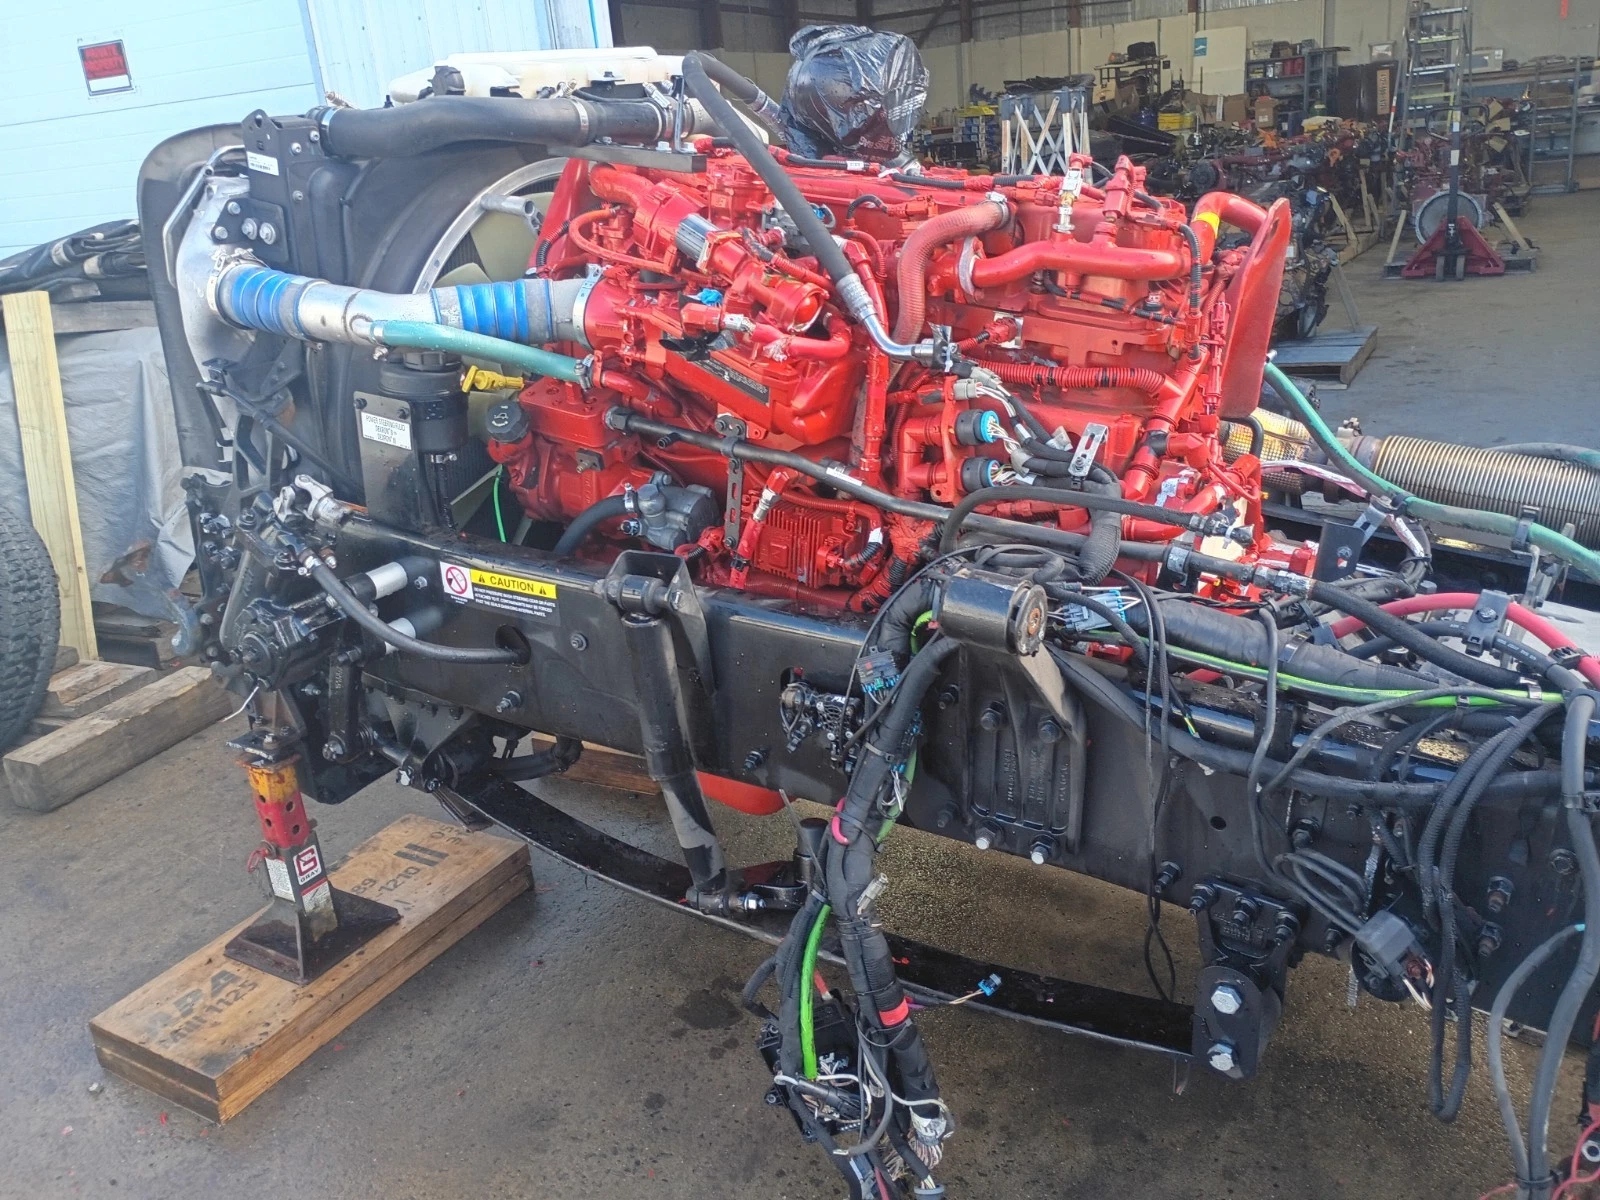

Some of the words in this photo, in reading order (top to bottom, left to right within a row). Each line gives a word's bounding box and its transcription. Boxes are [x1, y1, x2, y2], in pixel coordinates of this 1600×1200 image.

[489, 576, 534, 592] CAUTION
[300, 868, 320, 883] GRAY
[205, 980, 258, 1013] 1125
